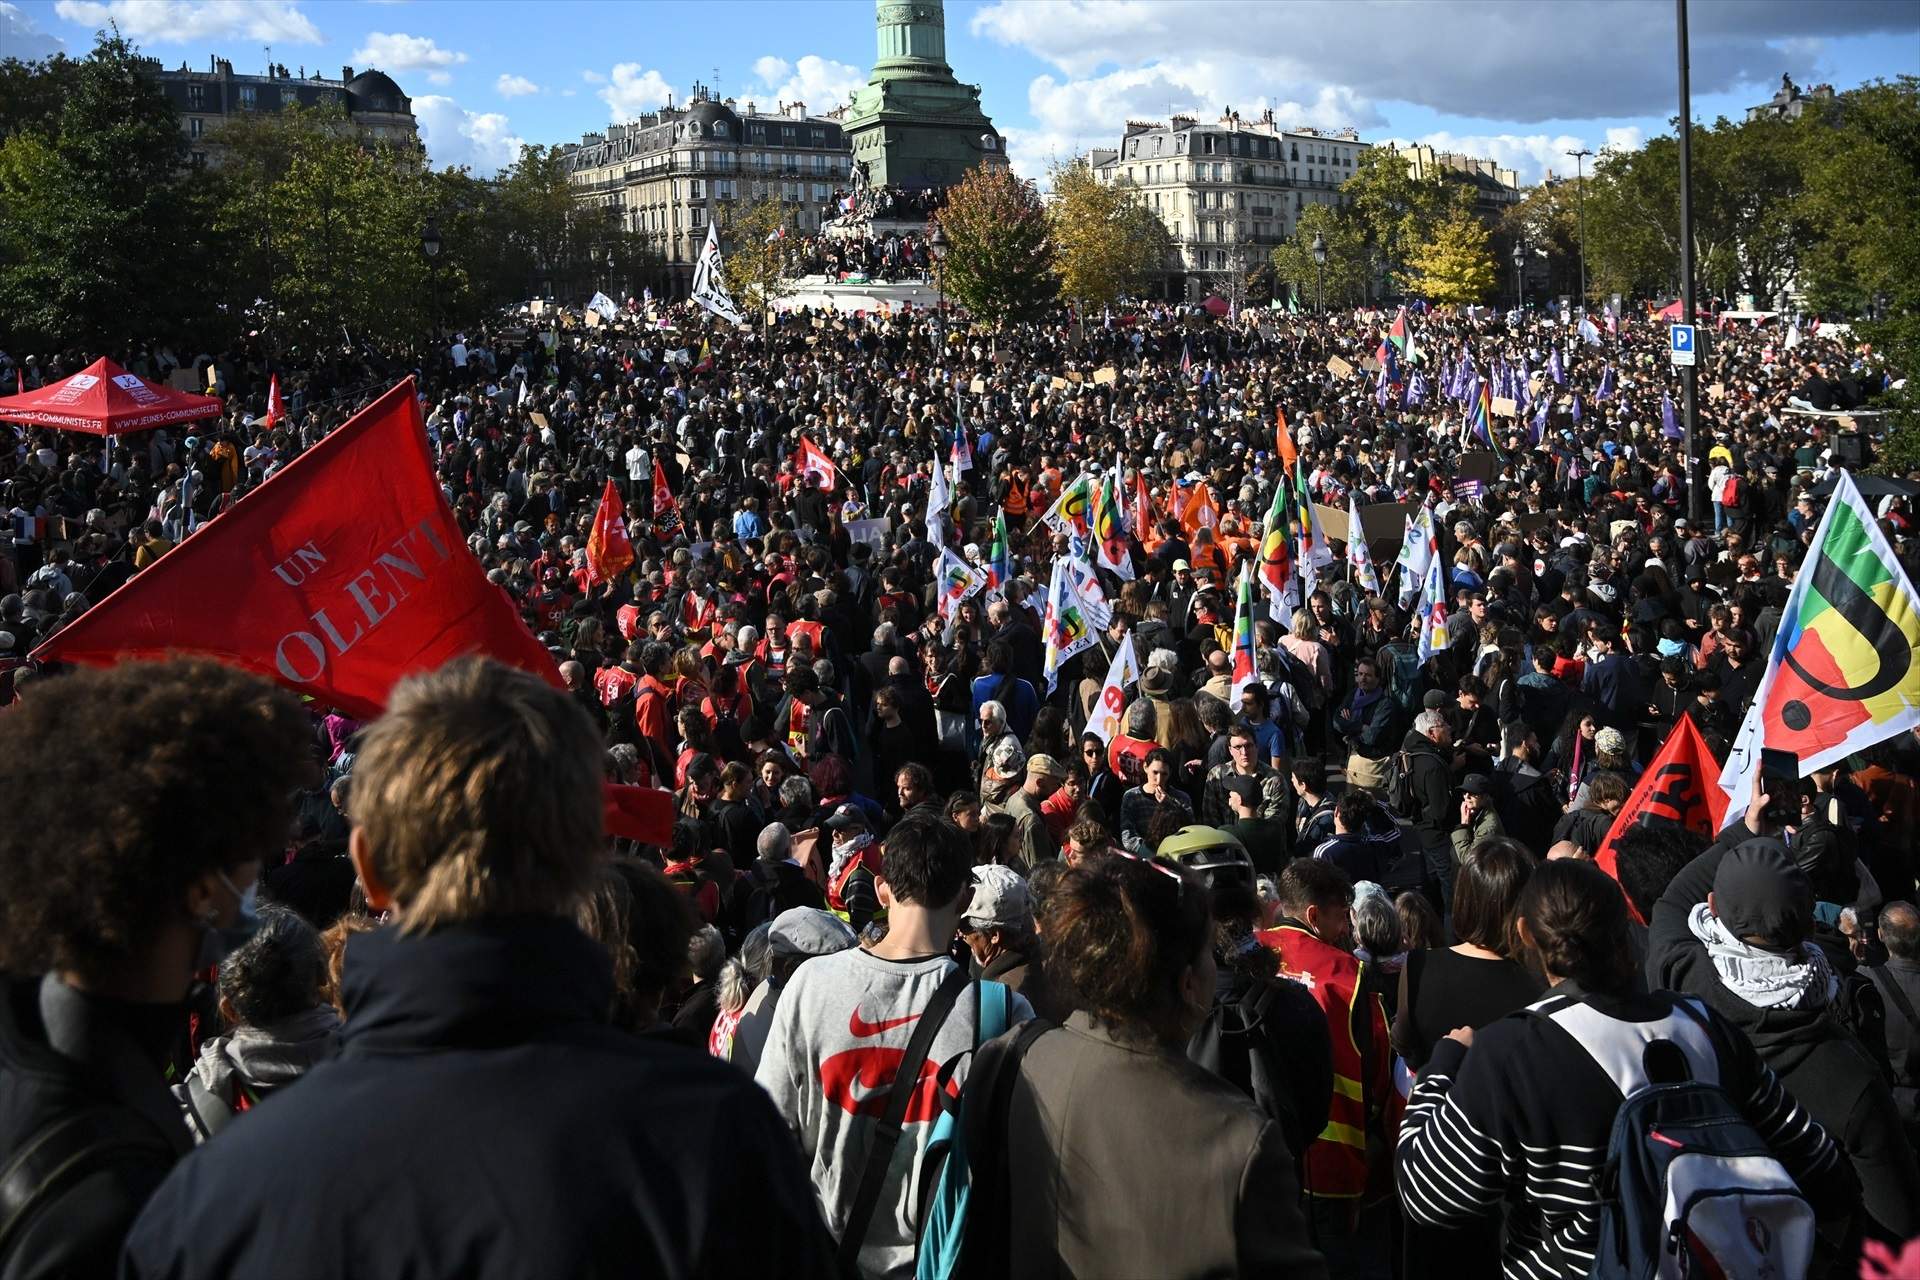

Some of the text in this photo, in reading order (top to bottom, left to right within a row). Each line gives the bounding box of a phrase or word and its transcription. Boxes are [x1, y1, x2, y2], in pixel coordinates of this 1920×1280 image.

[1677, 330, 1688, 347] P
[115, 404, 219, 429] WWW.JEUNES-COMMUNISTES.FR
[272, 540, 328, 587] UN
